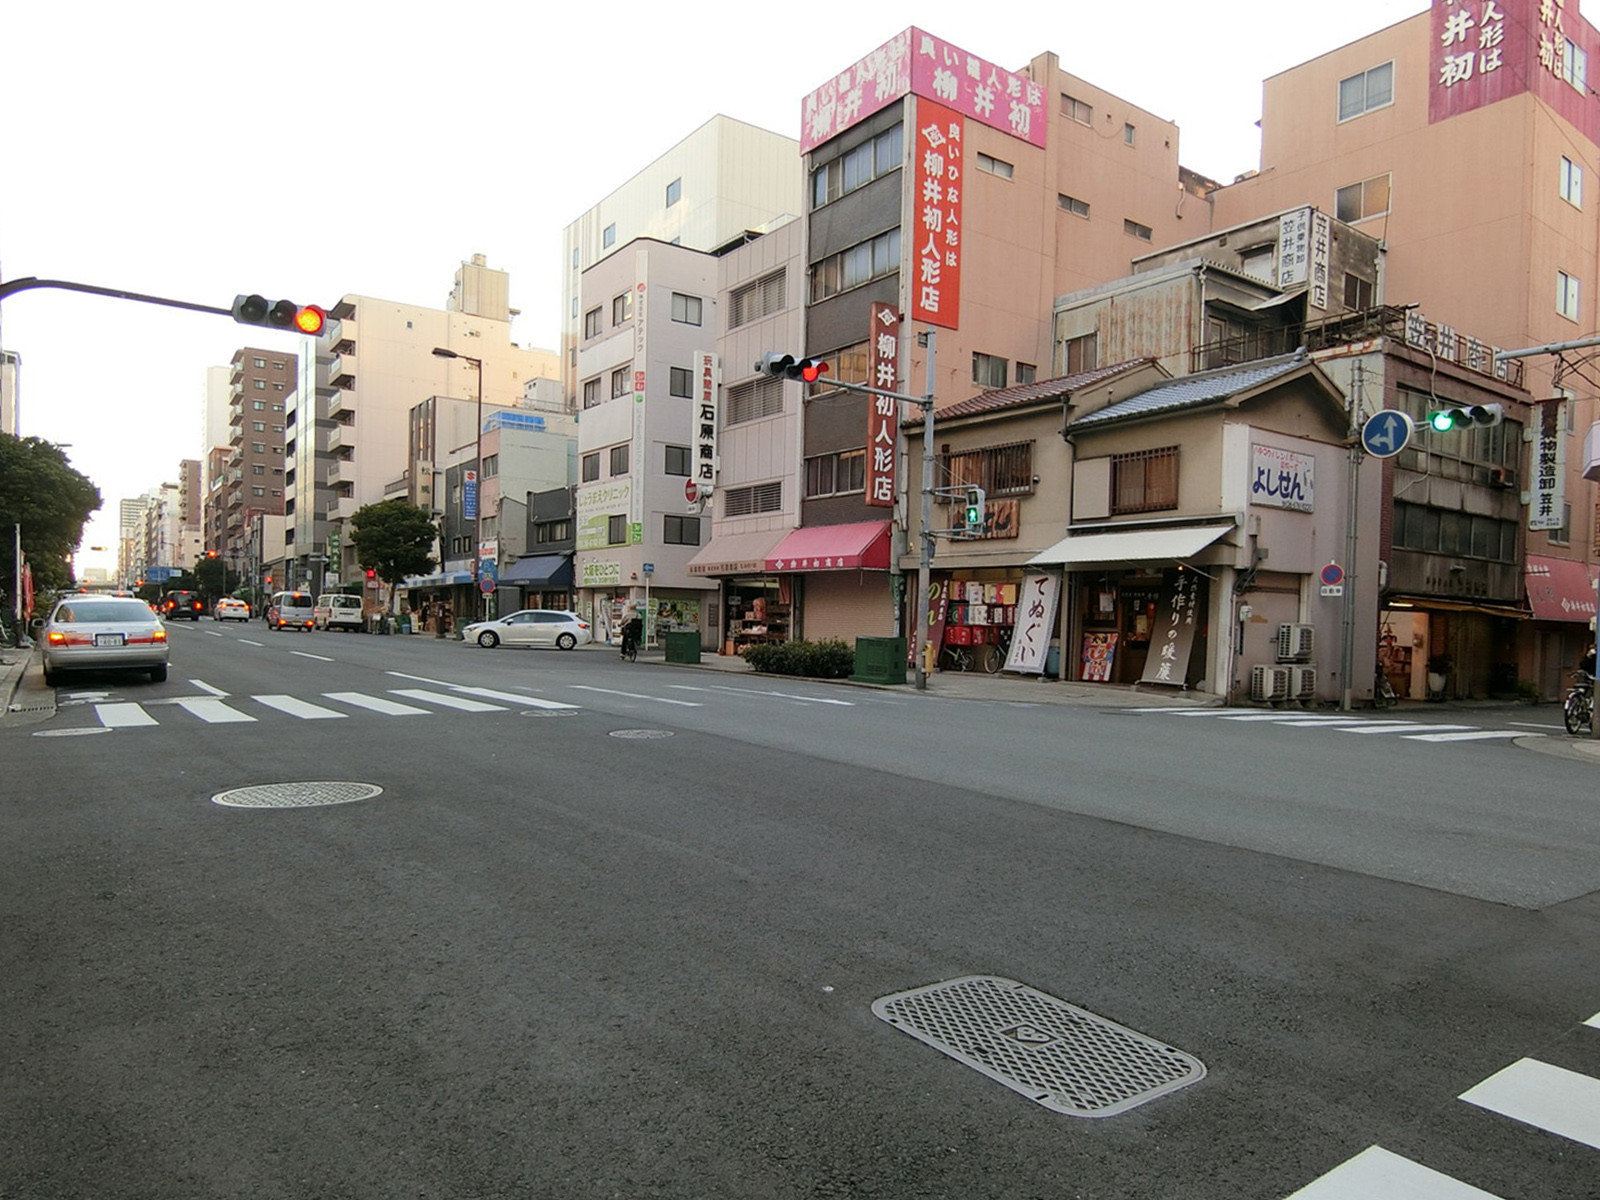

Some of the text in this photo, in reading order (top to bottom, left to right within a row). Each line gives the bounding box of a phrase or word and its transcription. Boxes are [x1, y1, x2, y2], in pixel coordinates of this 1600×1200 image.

[1438, 0, 1475, 87] 井初
[1479, 0, 1504, 74] 人形は
[932, 66, 1031, 135] 柳井初
[920, 150, 943, 313] 柳井初人形店
[945, 123, 960, 267] 良いひな人形は
[699, 403, 715, 480] 石原商店
[874, 332, 896, 501] 柳井初人形店
[1252, 466, 1305, 501] よしせん
[1020, 577, 1049, 663] てぬぐい
